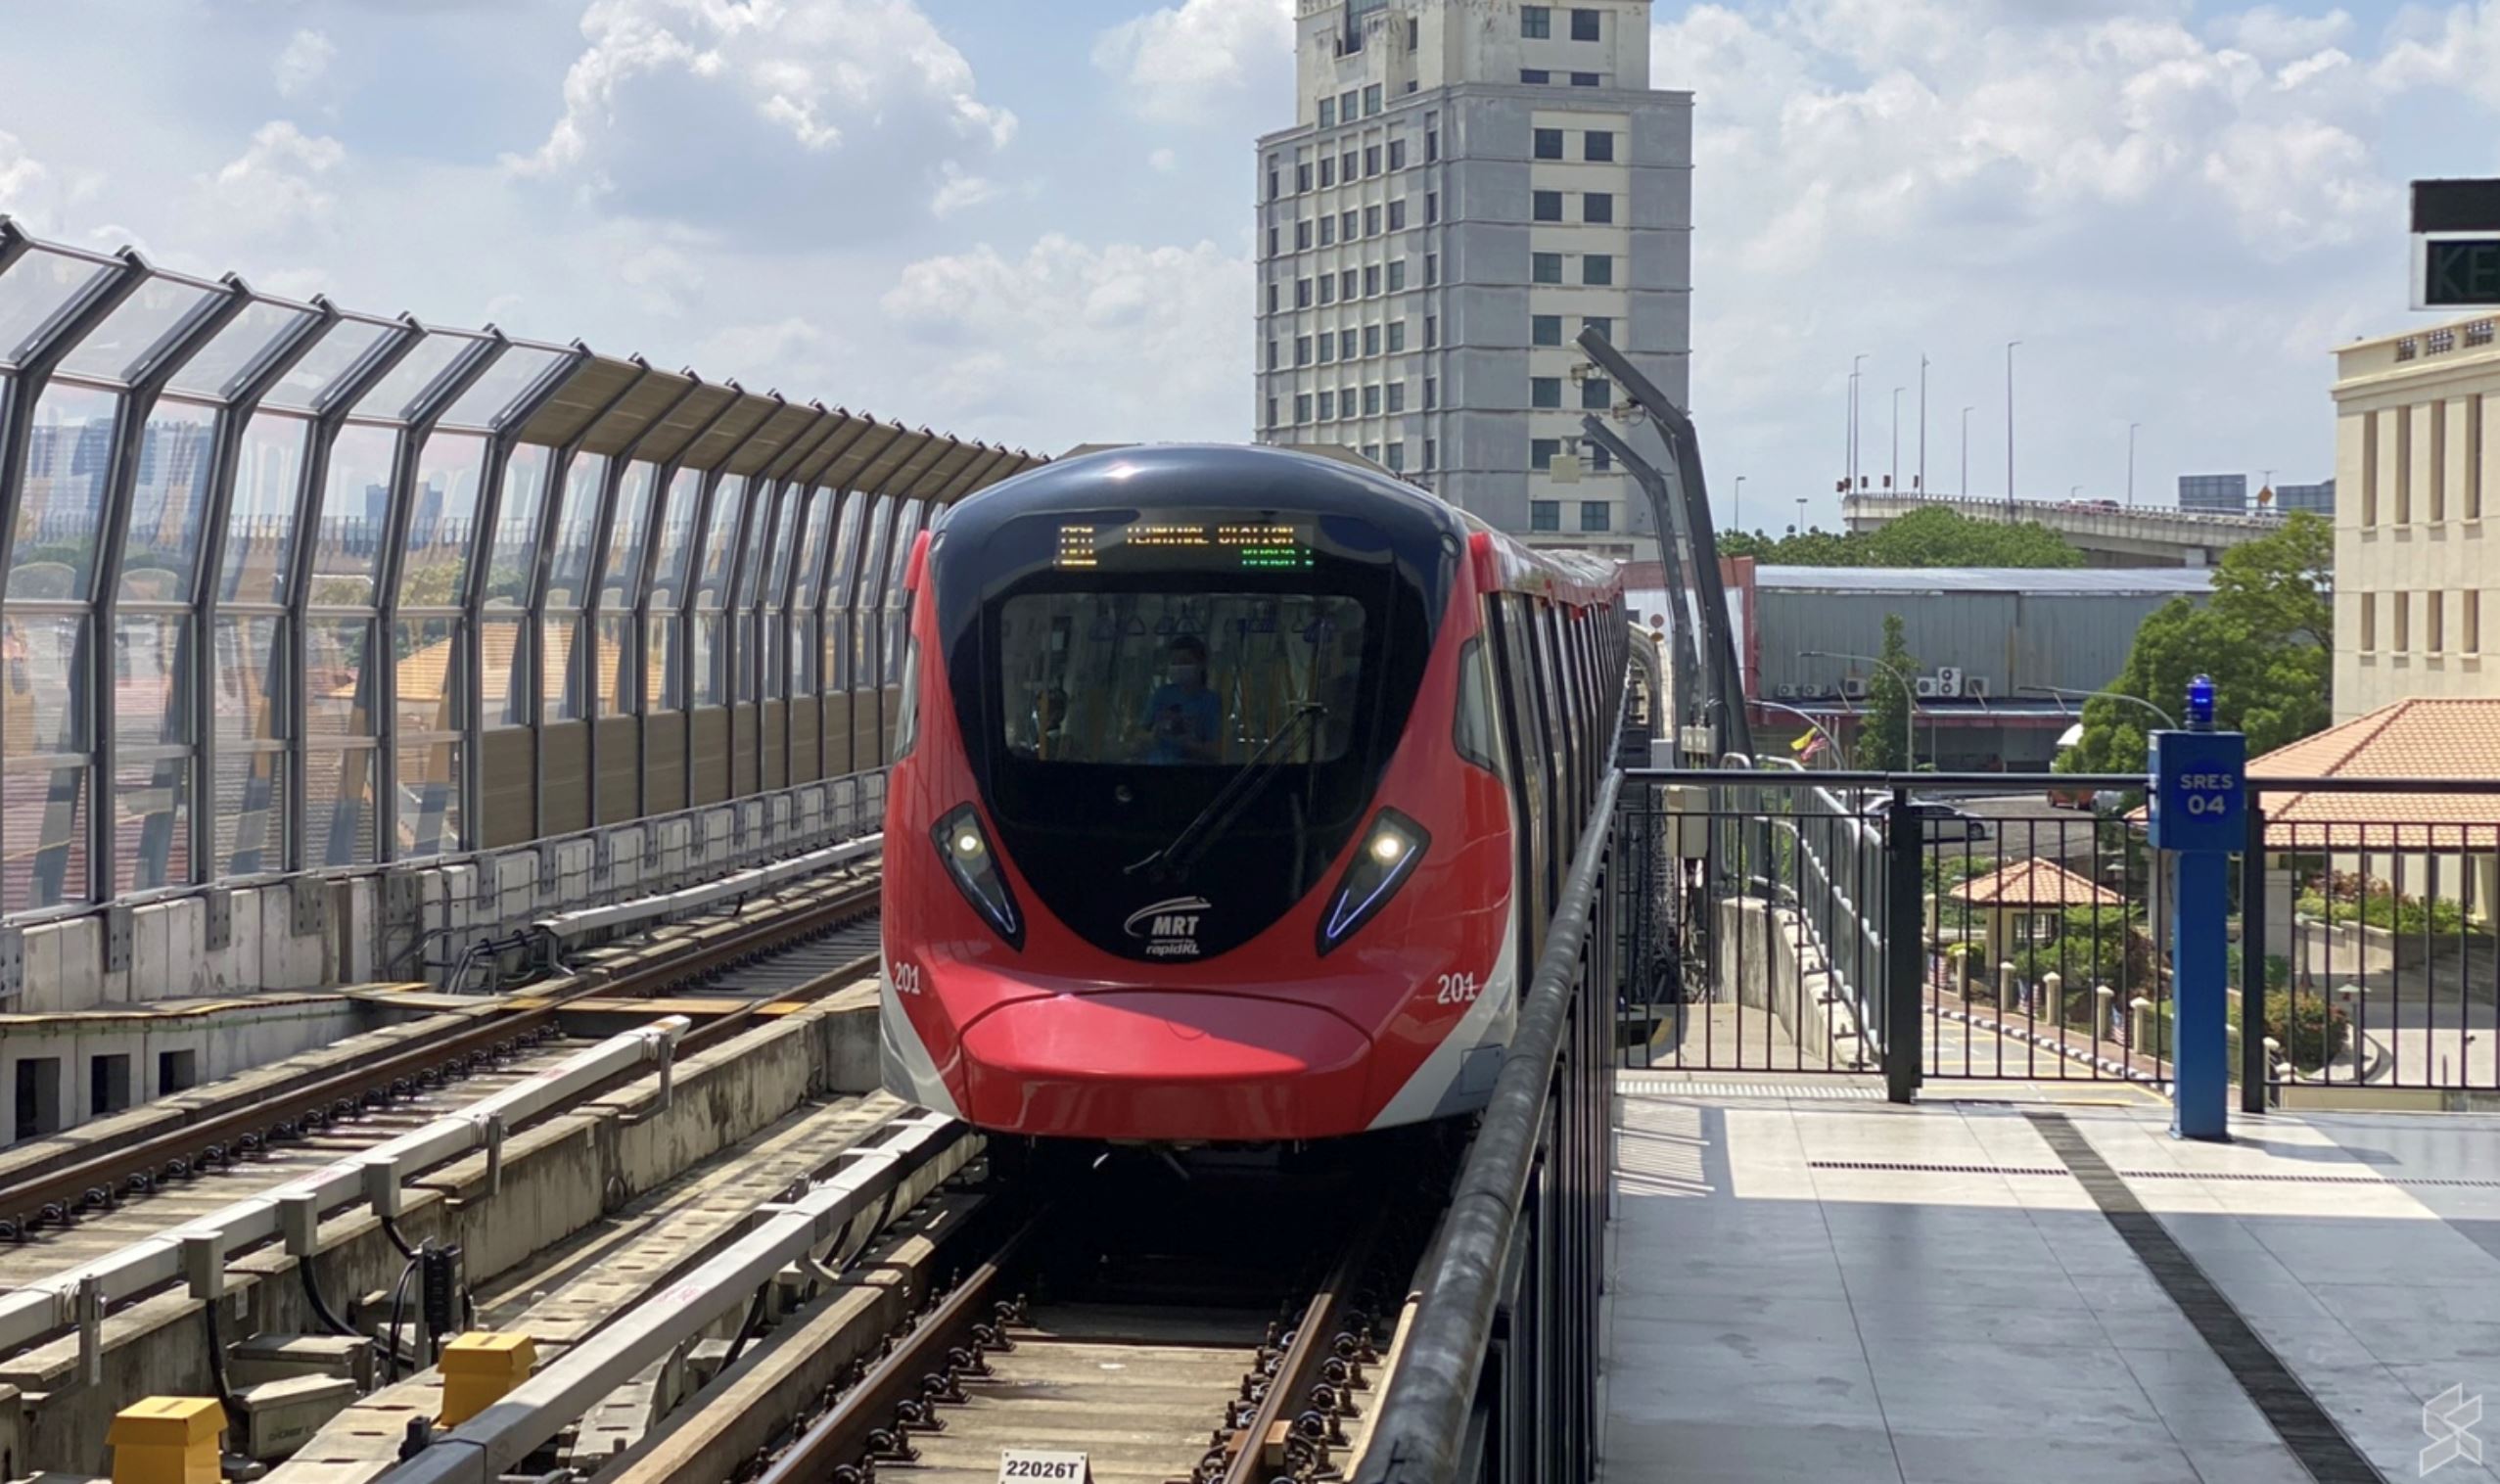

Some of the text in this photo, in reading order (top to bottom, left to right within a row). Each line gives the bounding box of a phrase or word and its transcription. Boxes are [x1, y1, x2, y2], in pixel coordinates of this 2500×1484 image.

[2180, 773, 2234, 790] SRES
[2188, 794, 2226, 814] 04
[1151, 915, 1200, 936] MRT
[895, 960, 921, 995] 201
[1437, 971, 1475, 1004] 201
[1005, 1460, 1080, 1479] 22026T
